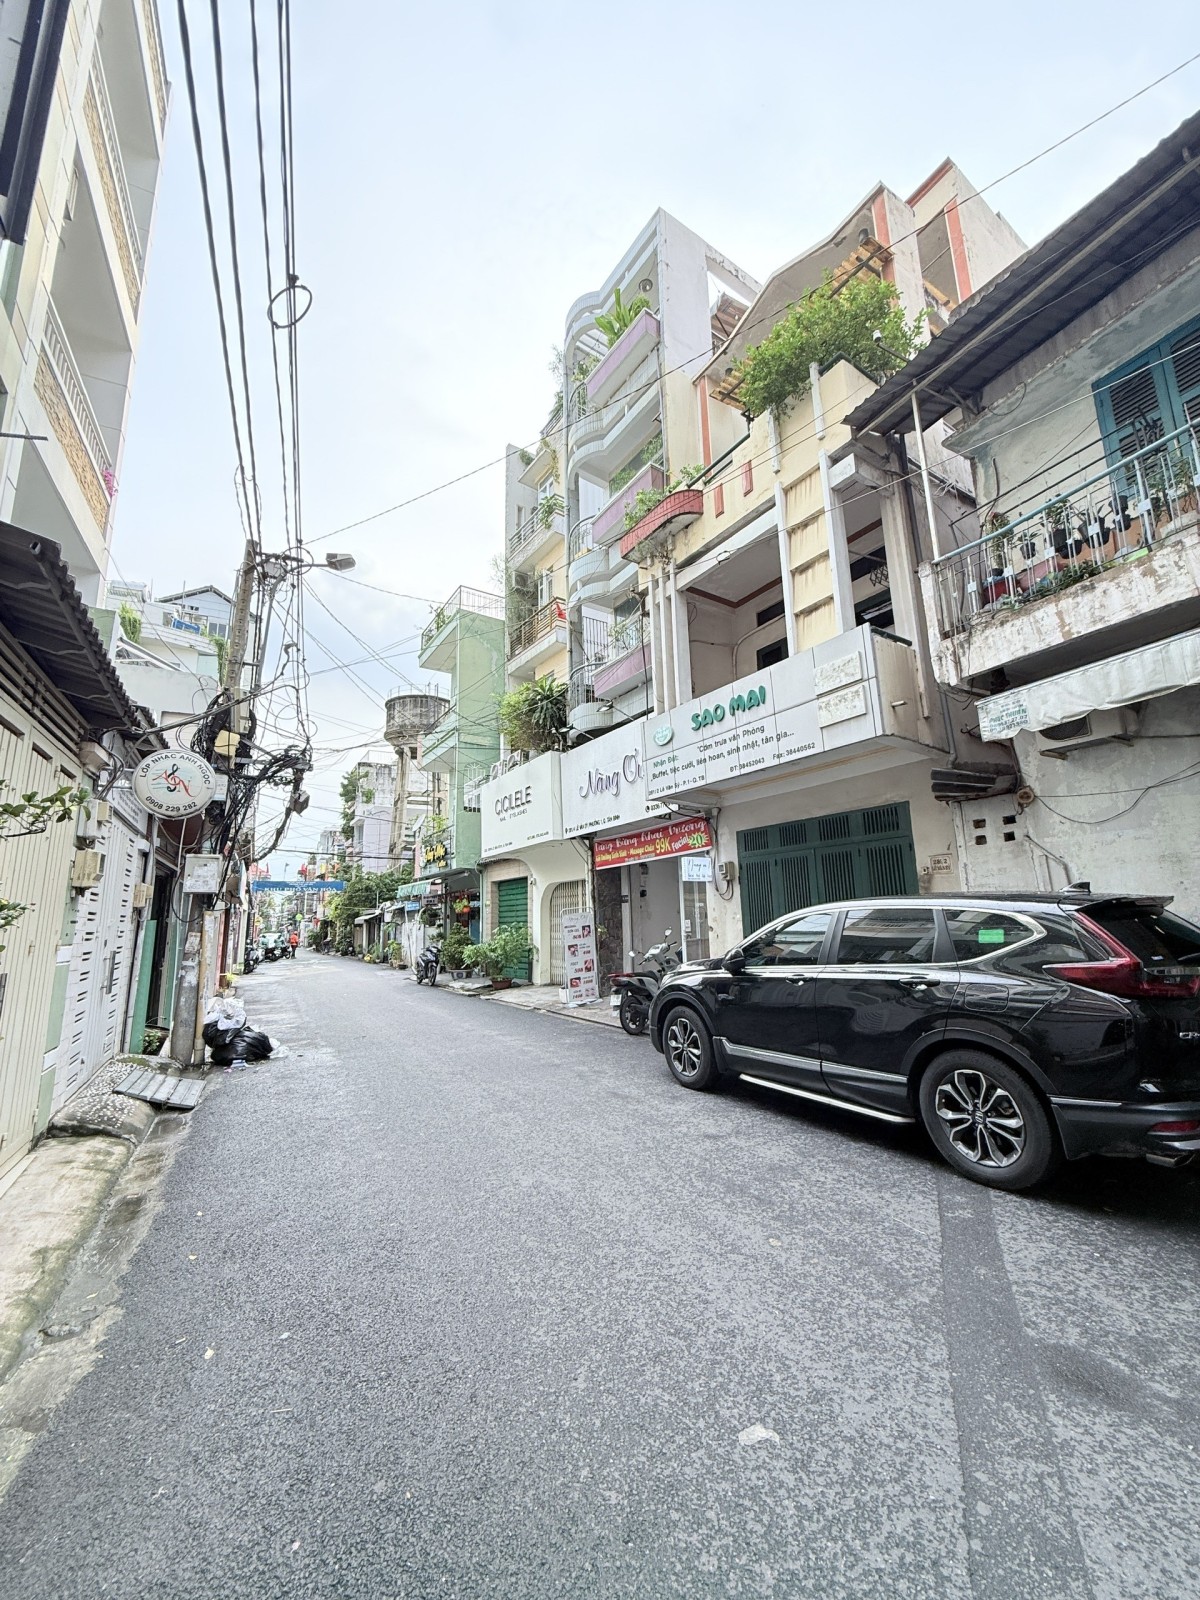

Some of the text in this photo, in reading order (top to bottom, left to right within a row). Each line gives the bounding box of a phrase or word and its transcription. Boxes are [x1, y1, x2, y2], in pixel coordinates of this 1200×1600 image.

[691, 685, 766, 731] SAO MAI
[179, 754, 198, 765] ANH
[579, 768, 620, 798] Nàng
[145, 795, 198, 813] 0908 229 282
[640, 830, 664, 842] Khai
[655, 836, 671, 854] 99K
[671, 832, 689, 852] Facial
